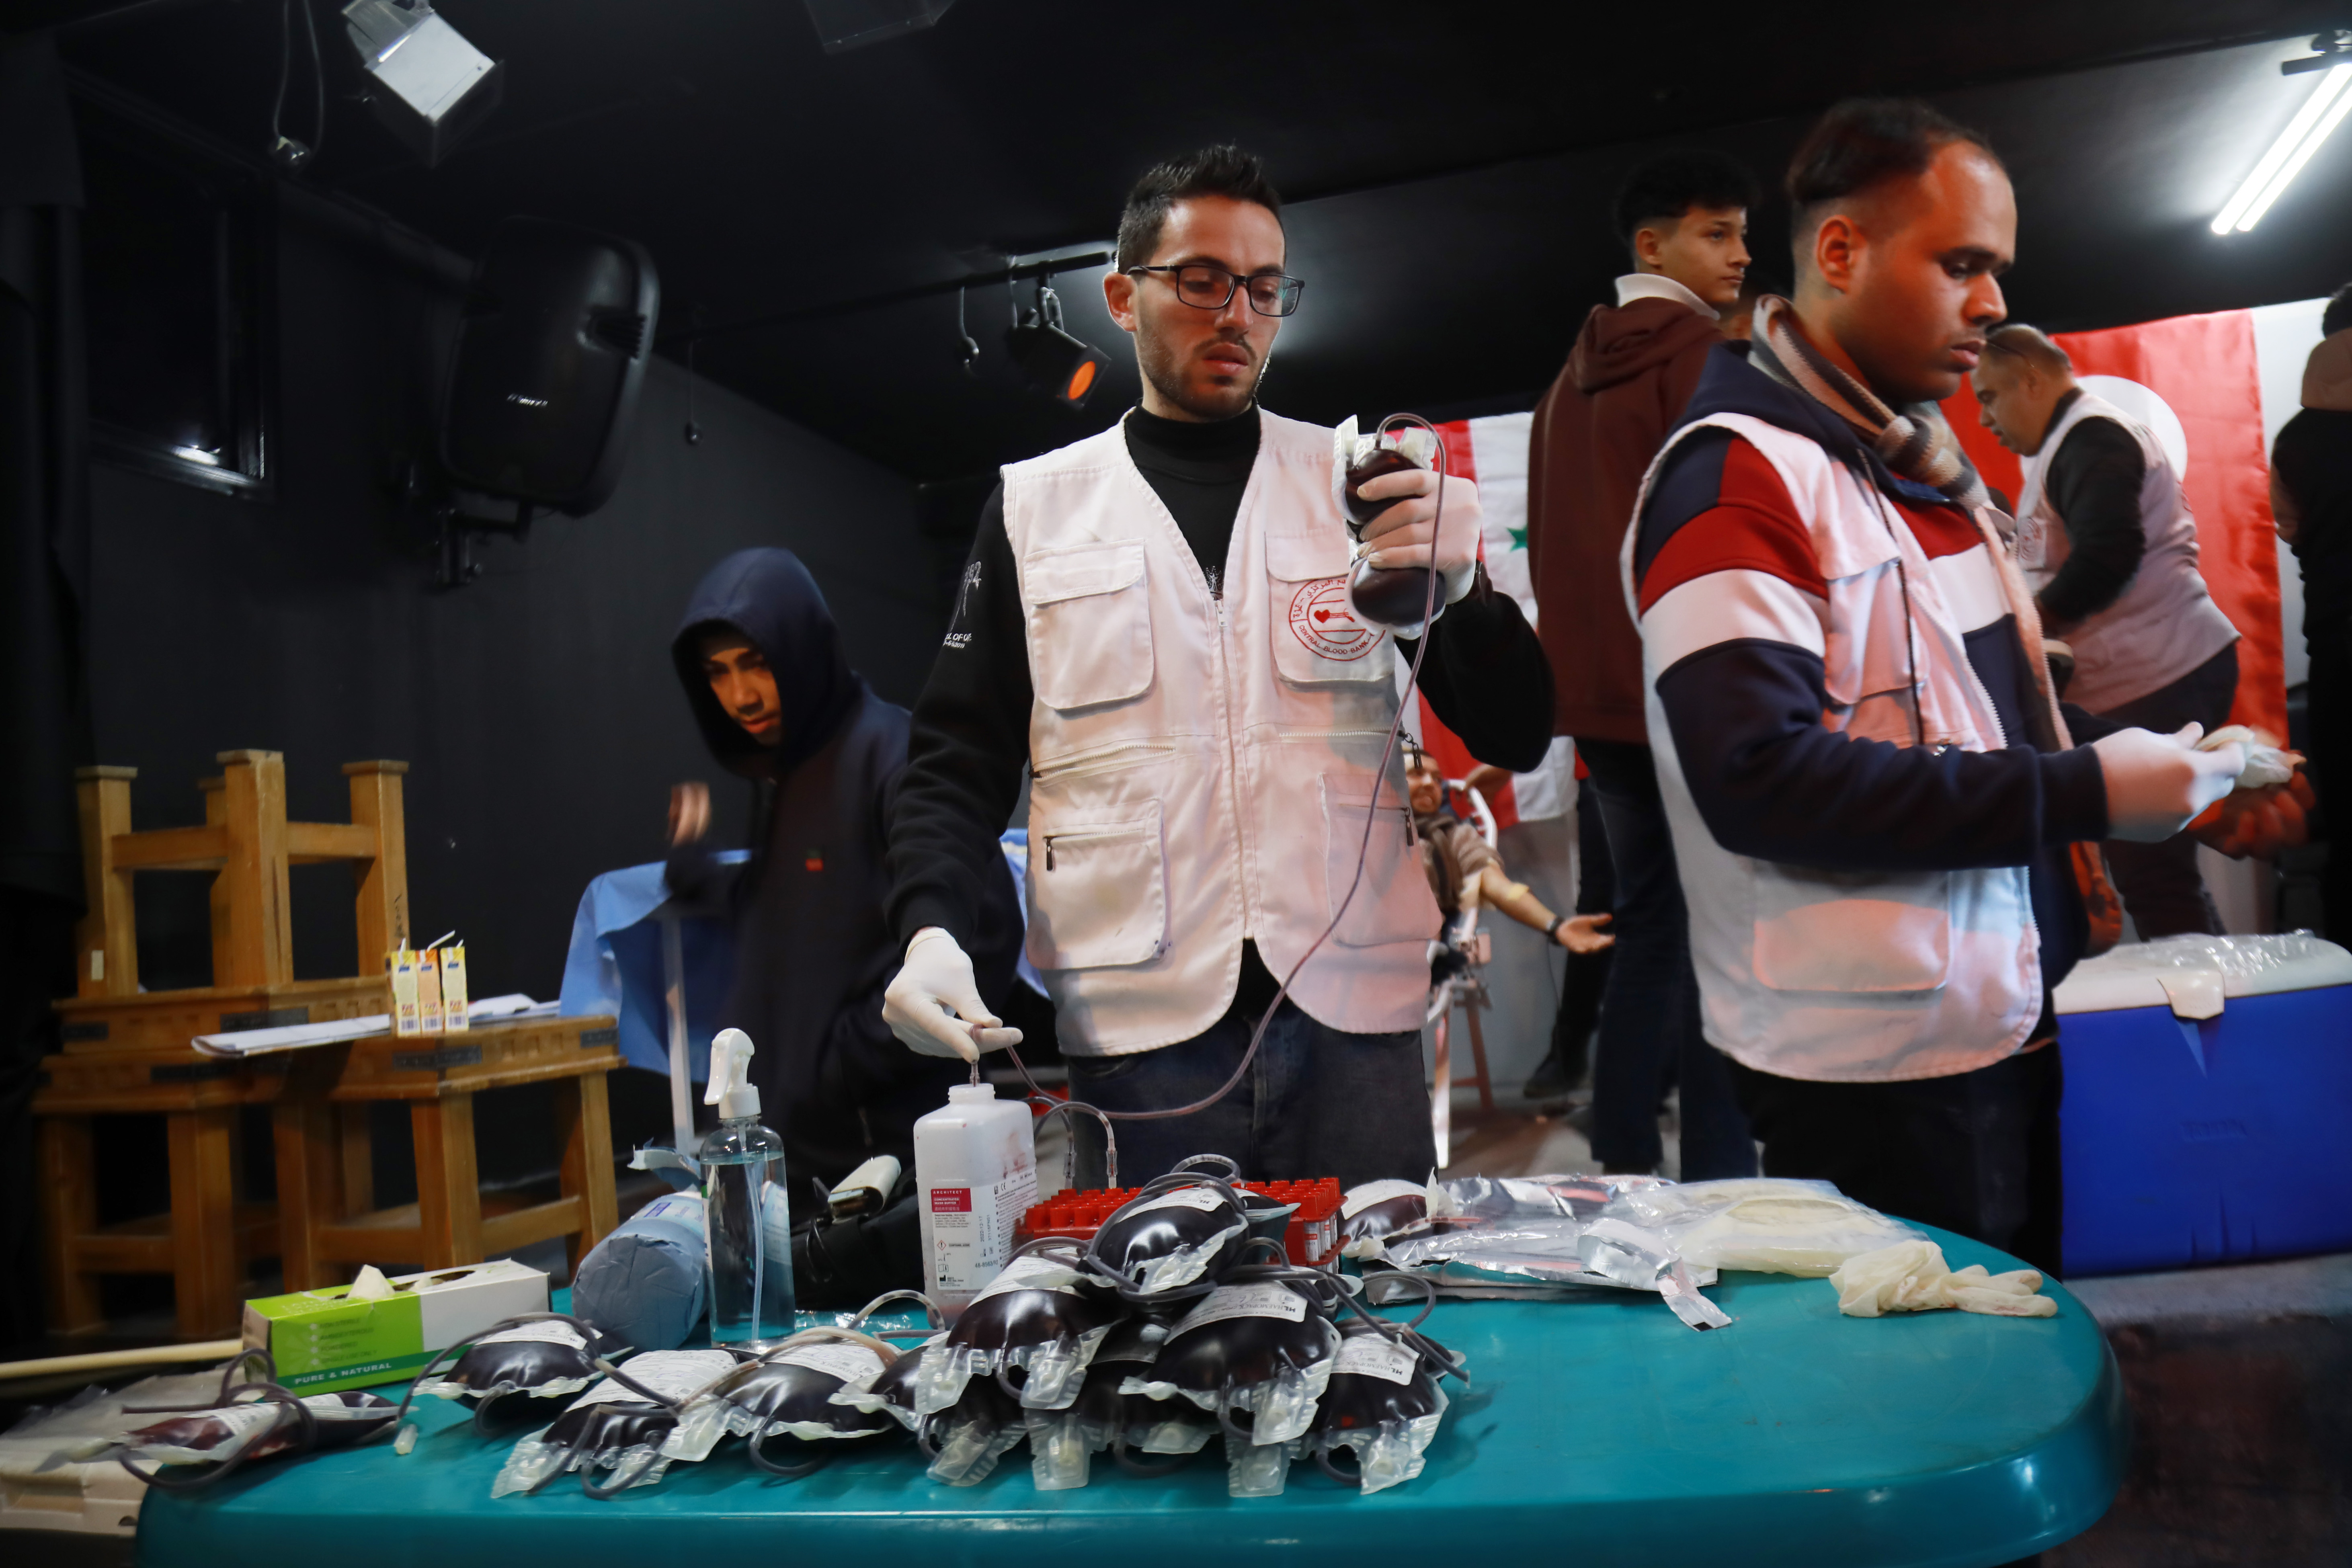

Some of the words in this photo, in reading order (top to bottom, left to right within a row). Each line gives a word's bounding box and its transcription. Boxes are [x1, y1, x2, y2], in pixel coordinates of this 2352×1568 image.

[953, 633, 964, 642] OF
[1299, 625, 1320, 648] CENTRAL
[1324, 646, 1348, 654] BLOOD
[1350, 640, 1368, 654] BANK
[1347, 1361, 1390, 1371] HAEMOPACK
[1390, 1367, 1403, 1375] HL
[295, 1374, 325, 1384] PURE
[341, 1362, 392, 1376] NATURAL
